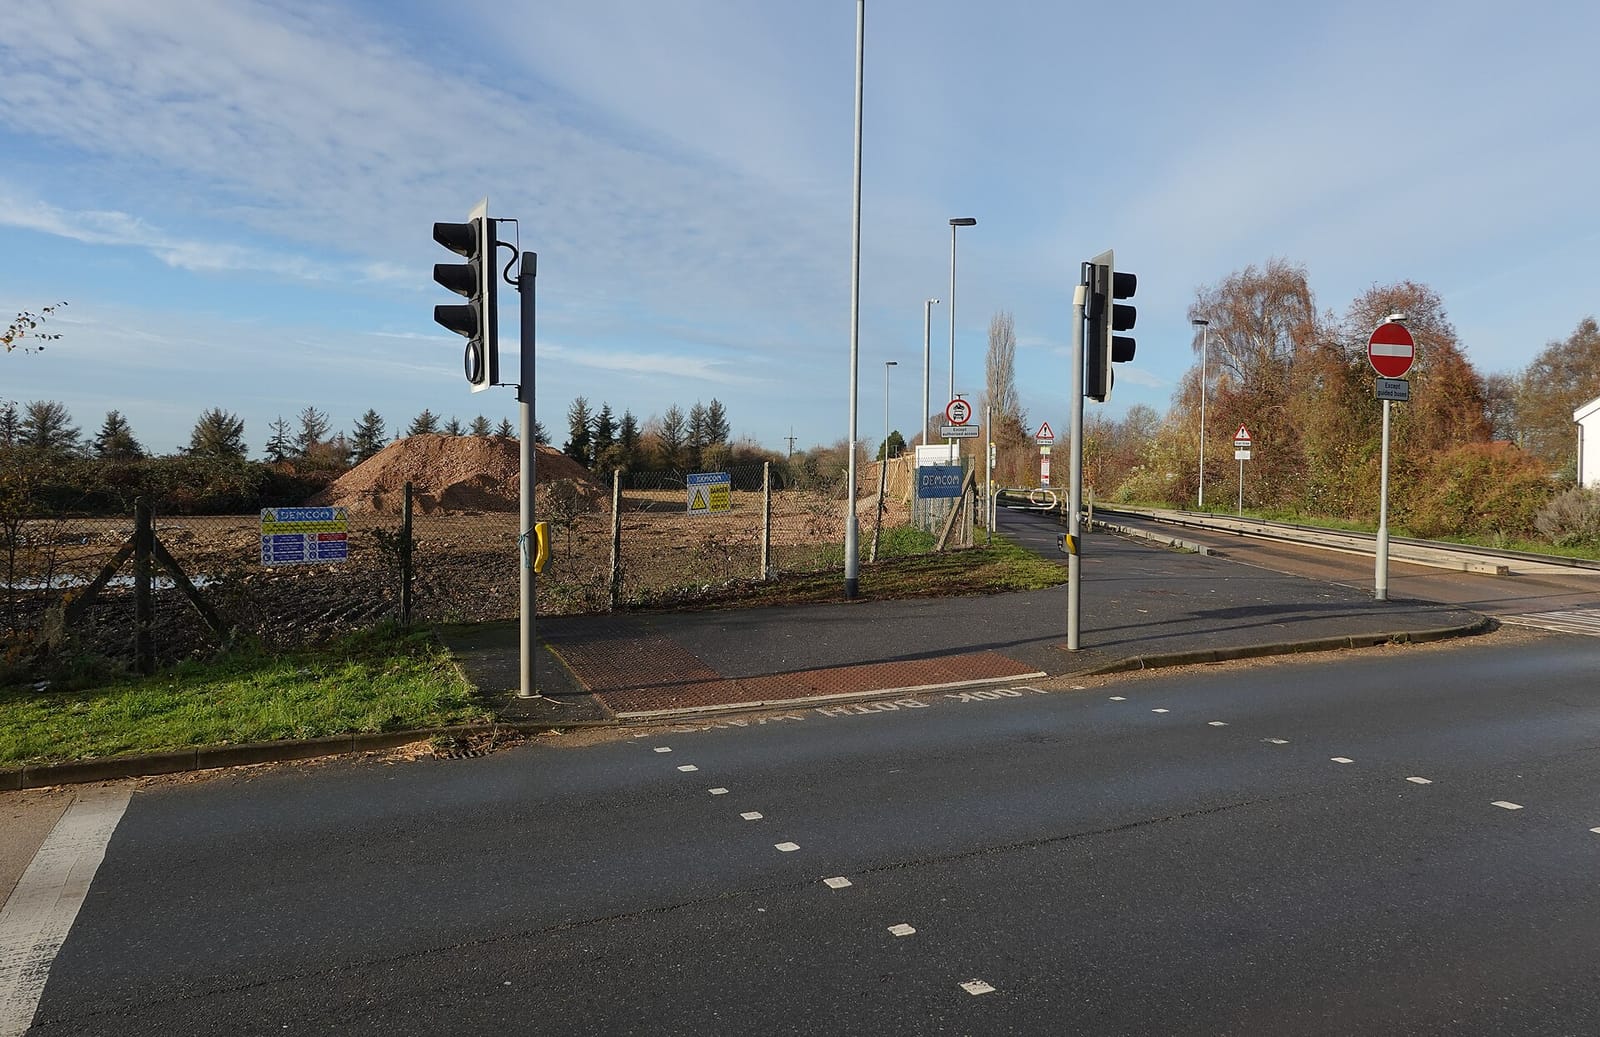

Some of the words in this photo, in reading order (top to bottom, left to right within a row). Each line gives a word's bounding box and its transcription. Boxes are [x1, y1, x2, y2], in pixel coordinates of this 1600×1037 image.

[1384, 382, 1401, 390] Except
[922, 475, 960, 486] DEMCOM
[280, 511, 330, 520] DEMCOM
[945, 686, 1049, 703] LOOK
[815, 698, 931, 717] BOTH
